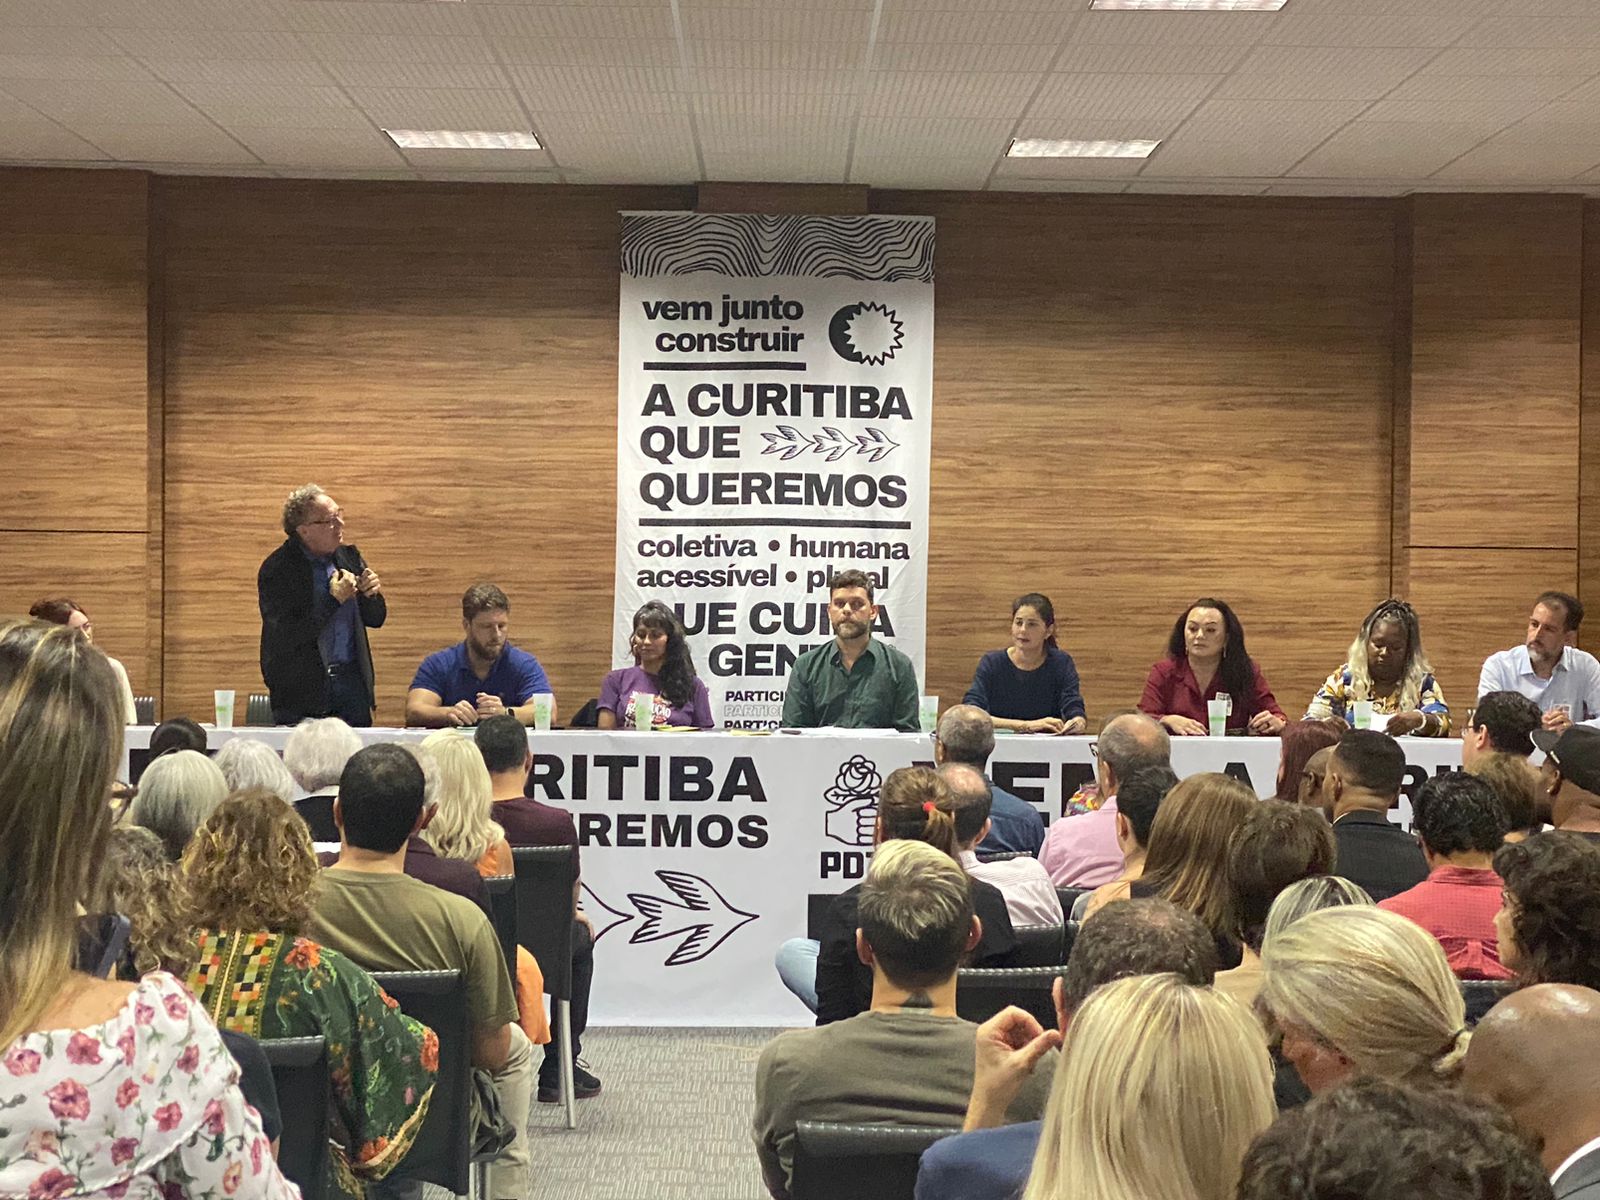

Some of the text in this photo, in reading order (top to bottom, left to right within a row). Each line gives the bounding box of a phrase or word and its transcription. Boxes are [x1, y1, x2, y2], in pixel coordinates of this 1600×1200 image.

[643, 295, 804, 327] vem junto
[655, 326, 804, 352] construir
[640, 383, 913, 420] A CURITIBA
[640, 425, 740, 465] QUE
[640, 472, 908, 512] QUEREMOS
[637, 534, 910, 560] coletiva humana
[637, 563, 889, 593] acessível plal
[674, 601, 895, 637] UE CUIA
[708, 643, 823, 676] GEN
[724, 704, 783, 717] PARTICI
[725, 690, 784, 702] PARTICI
[724, 720, 783, 729] PARTICI
[523, 754, 767, 802] RITIBA
[571, 813, 769, 849] REMOS
[820, 851, 873, 879] PD
